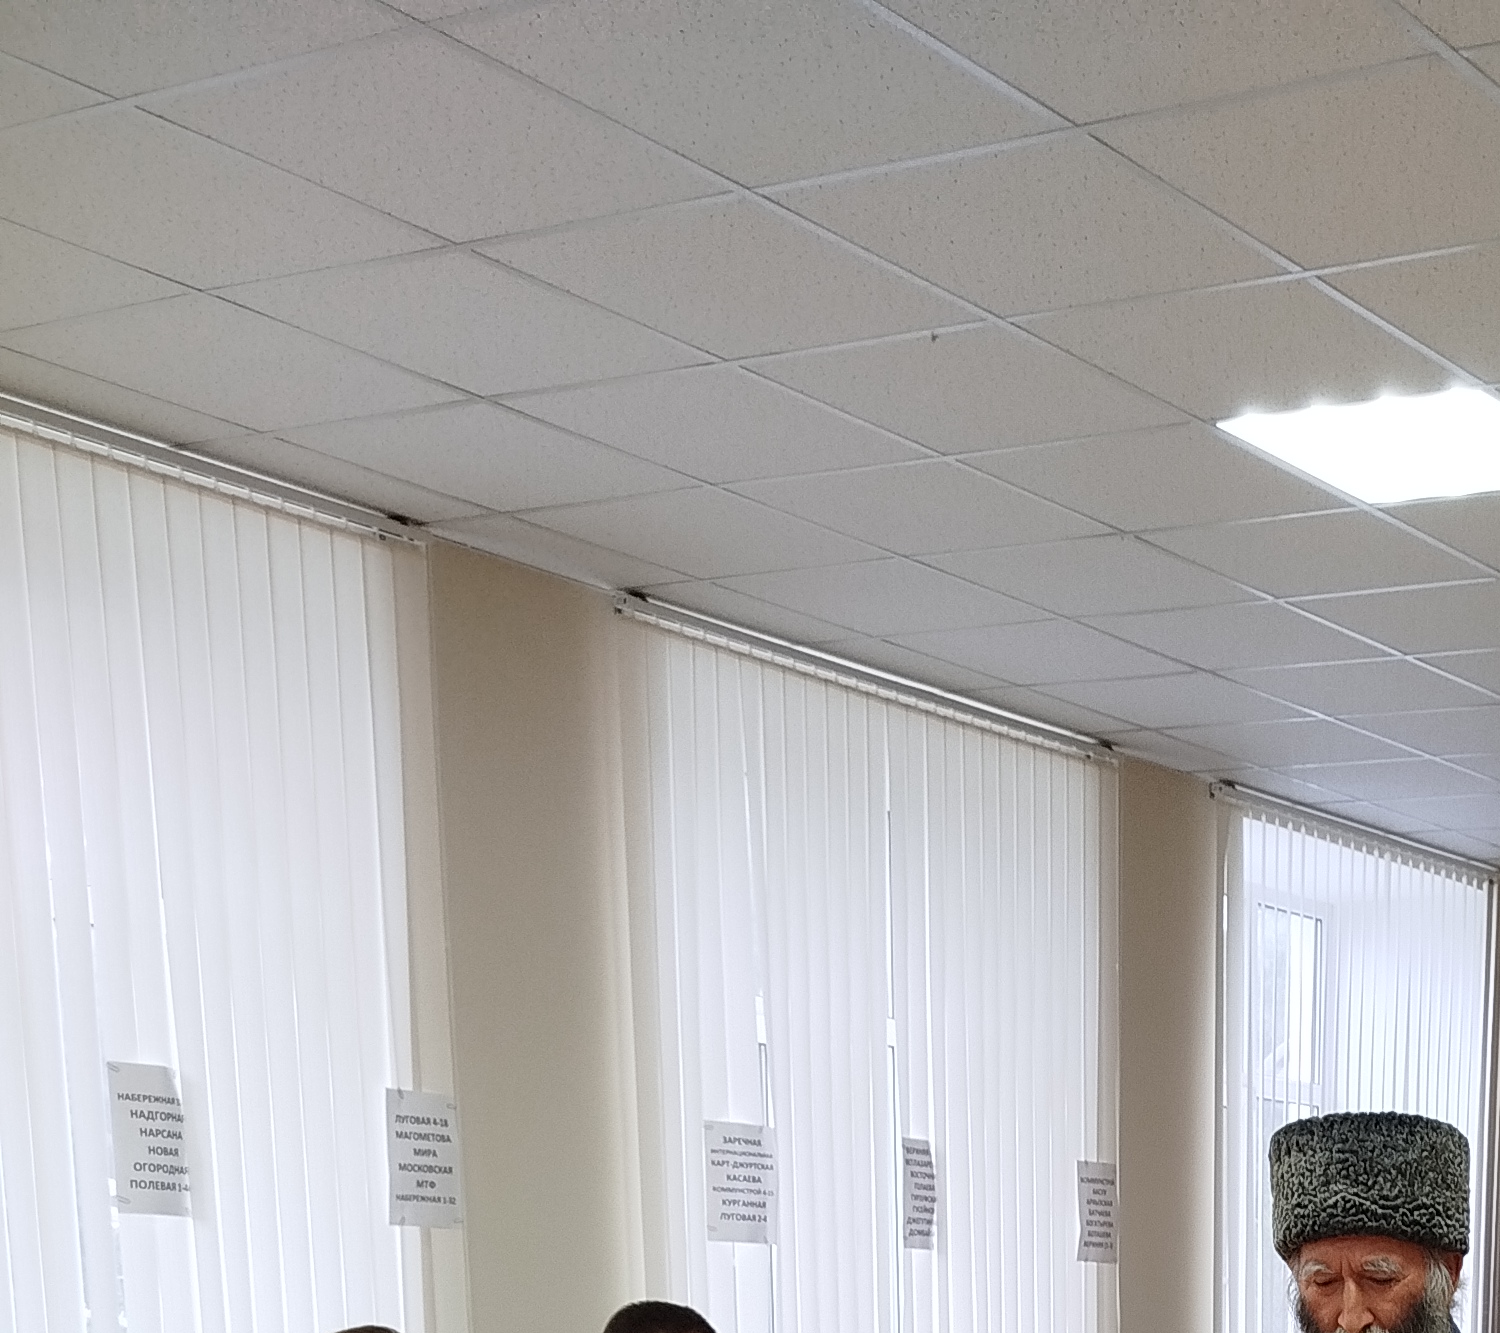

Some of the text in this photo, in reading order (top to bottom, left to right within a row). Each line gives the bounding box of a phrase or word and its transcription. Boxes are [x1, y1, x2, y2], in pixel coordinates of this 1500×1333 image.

[117, 1092, 175, 1105] НАБЕРЕЖНАЯ
[395, 1114, 431, 1126] ЛУГОВАЯ
[139, 1128, 183, 1140] НАРСАНА
[723, 1135, 762, 1147] ЗАРЕЧНАЯ
[148, 1146, 179, 1157] НОВАЯ
[413, 1148, 438, 1158] МИРА
[398, 1163, 453, 1174] МОСКОВСКАЯ
[726, 1174, 762, 1184] КАСАЕВА
[130, 1179, 176, 1191] ПОЛЕВАЯ
[721, 1199, 766, 1209] КУРГАННАЯ
[720, 1212, 757, 1222] ЛУГОВАЯ
